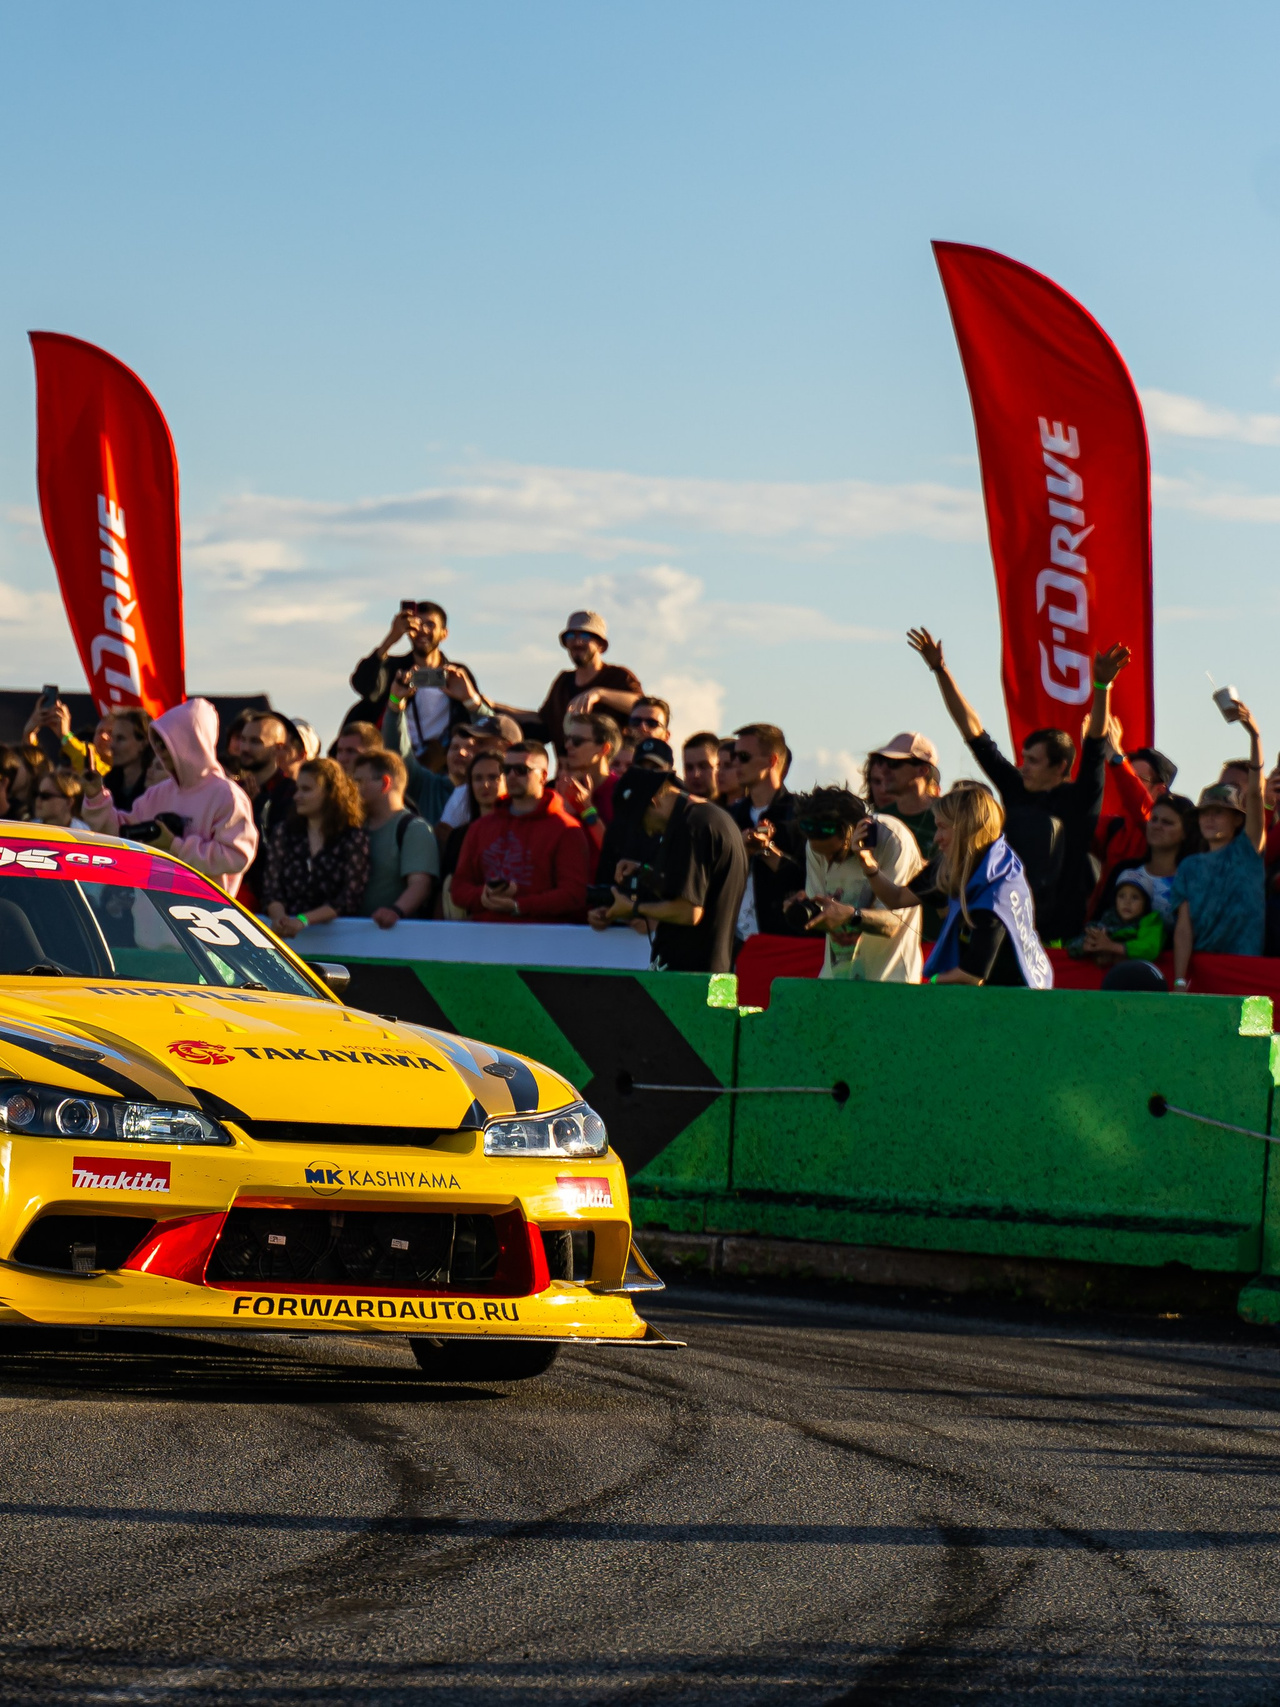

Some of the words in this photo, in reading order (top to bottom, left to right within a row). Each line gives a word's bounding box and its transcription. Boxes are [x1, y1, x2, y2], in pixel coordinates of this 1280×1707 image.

[65, 852, 112, 867] GP
[168, 905, 276, 949] 31
[233, 1046, 448, 1073] TAKAYAMA
[341, 1044, 393, 1054] MOTOR
[395, 1048, 422, 1056] OIL
[304, 1168, 344, 1185] MK
[348, 1170, 462, 1190] KASHIYAMA
[233, 1297, 520, 1322] FORWARDAUTO.RU
